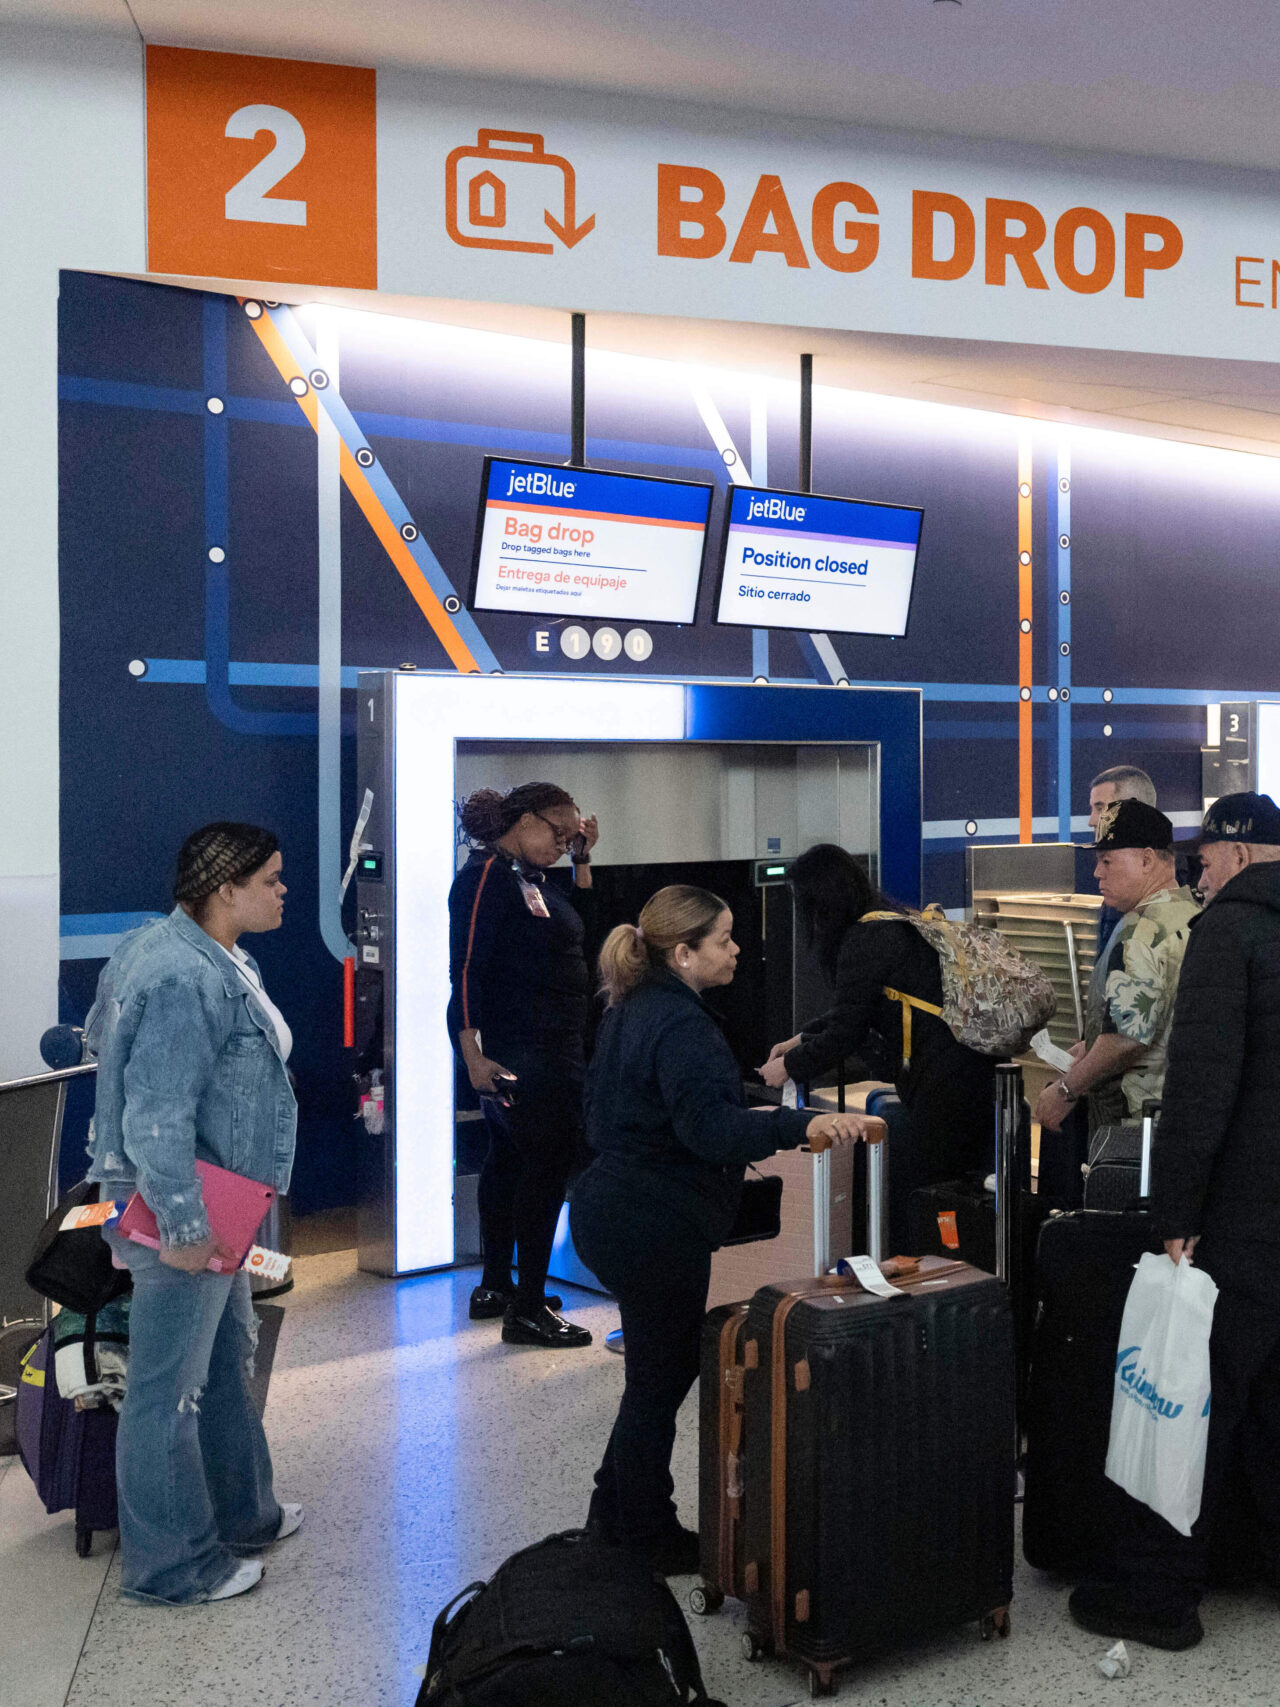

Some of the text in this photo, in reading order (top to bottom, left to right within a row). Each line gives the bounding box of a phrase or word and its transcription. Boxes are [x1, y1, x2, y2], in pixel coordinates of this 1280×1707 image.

[224, 103, 308, 227] 2
[657, 163, 1184, 299] BAG DROP
[506, 470, 576, 499] jetBlue
[747, 496, 806, 522] jetBlue
[504, 517, 595, 548] Bag drop
[501, 542, 591, 558] Drop tagged bags here
[742, 547, 868, 576] Position closed
[498, 565, 628, 591] Entrega de equipaje
[738, 585, 811, 603] Sitio cerrado
[367, 698, 374, 722] 1
[1230, 714, 1240, 732] 3
